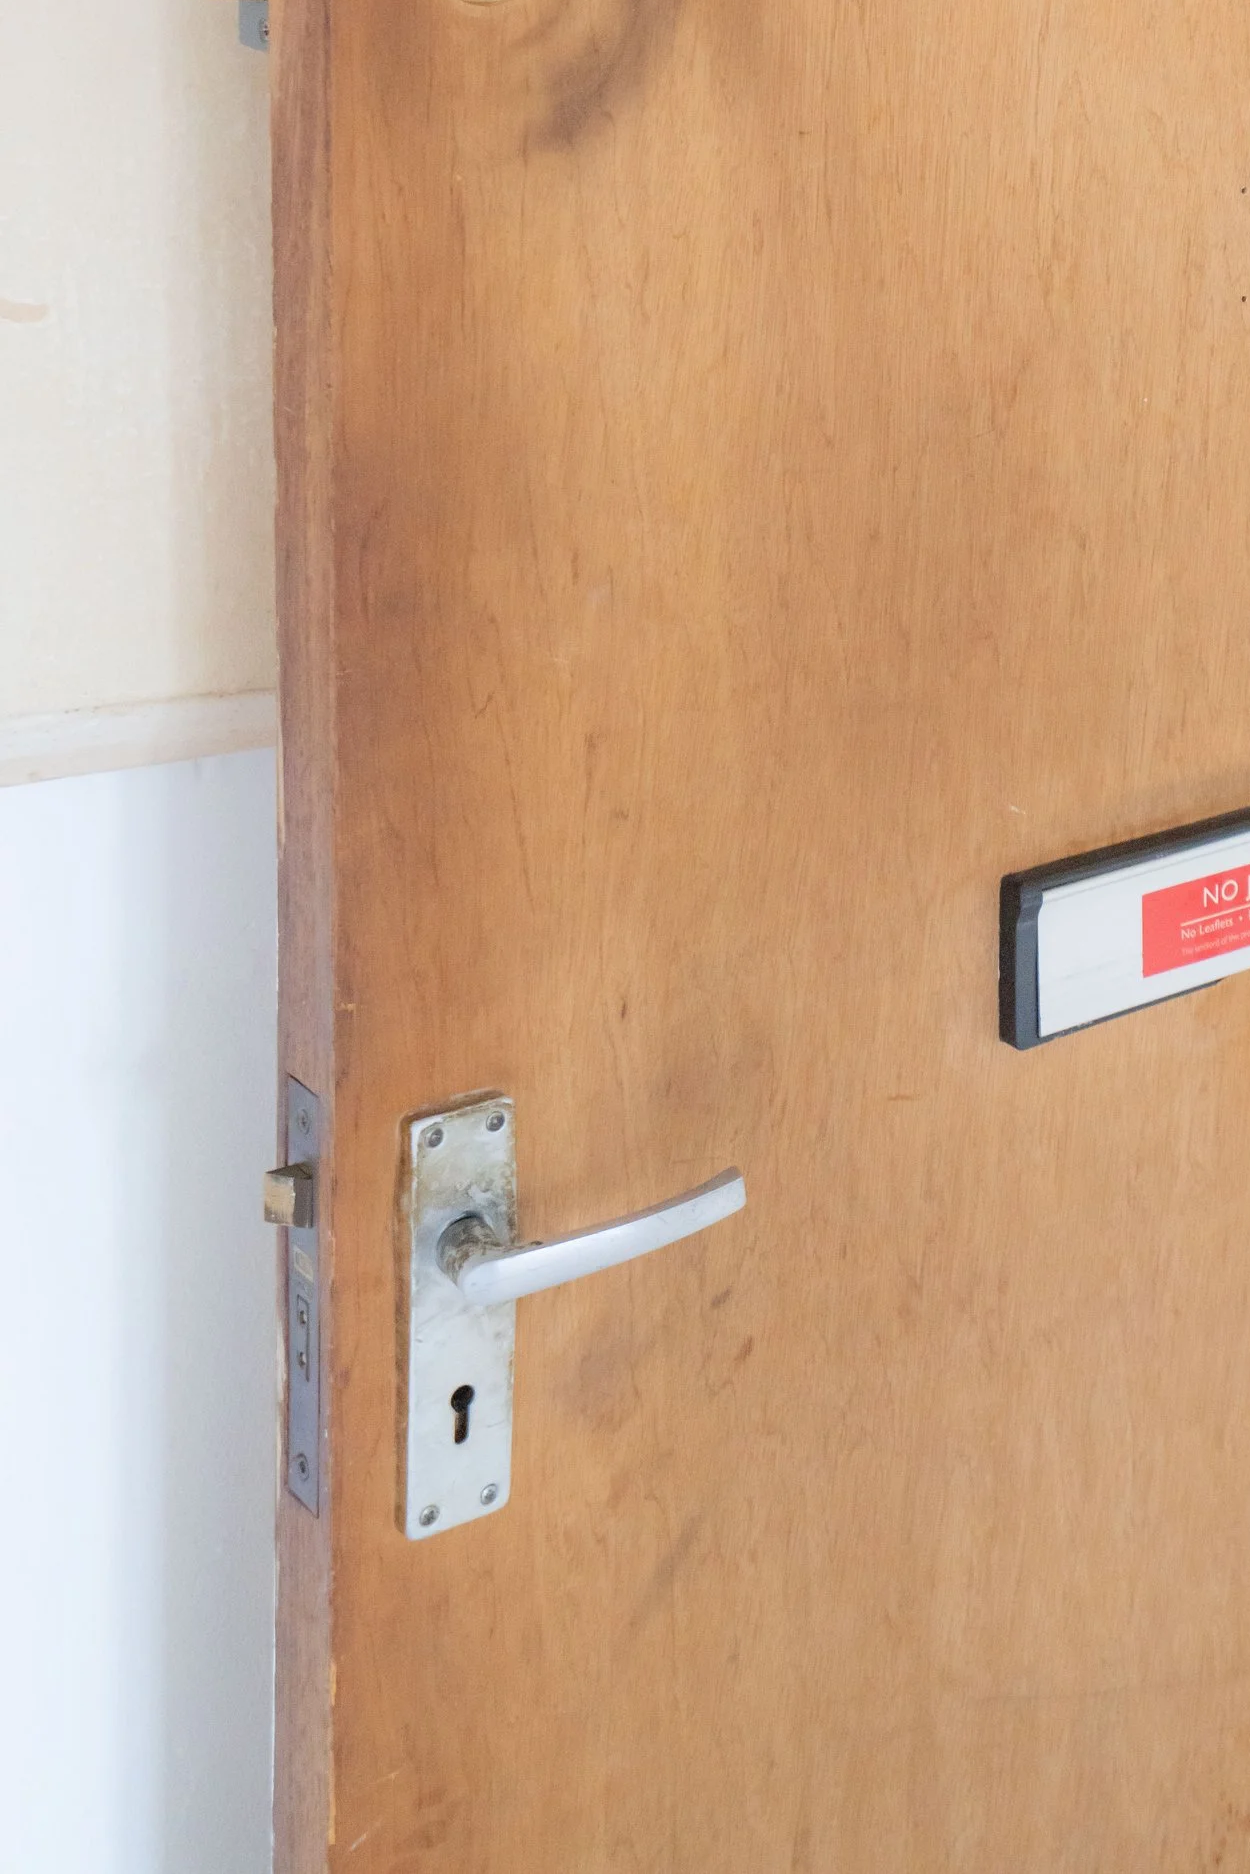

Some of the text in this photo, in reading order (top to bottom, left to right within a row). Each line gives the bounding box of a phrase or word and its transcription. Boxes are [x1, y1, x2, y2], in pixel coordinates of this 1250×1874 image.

[1203, 879, 1238, 908] NO
[1181, 929, 1196, 940] No
[1199, 918, 1233, 935] Leaflets
